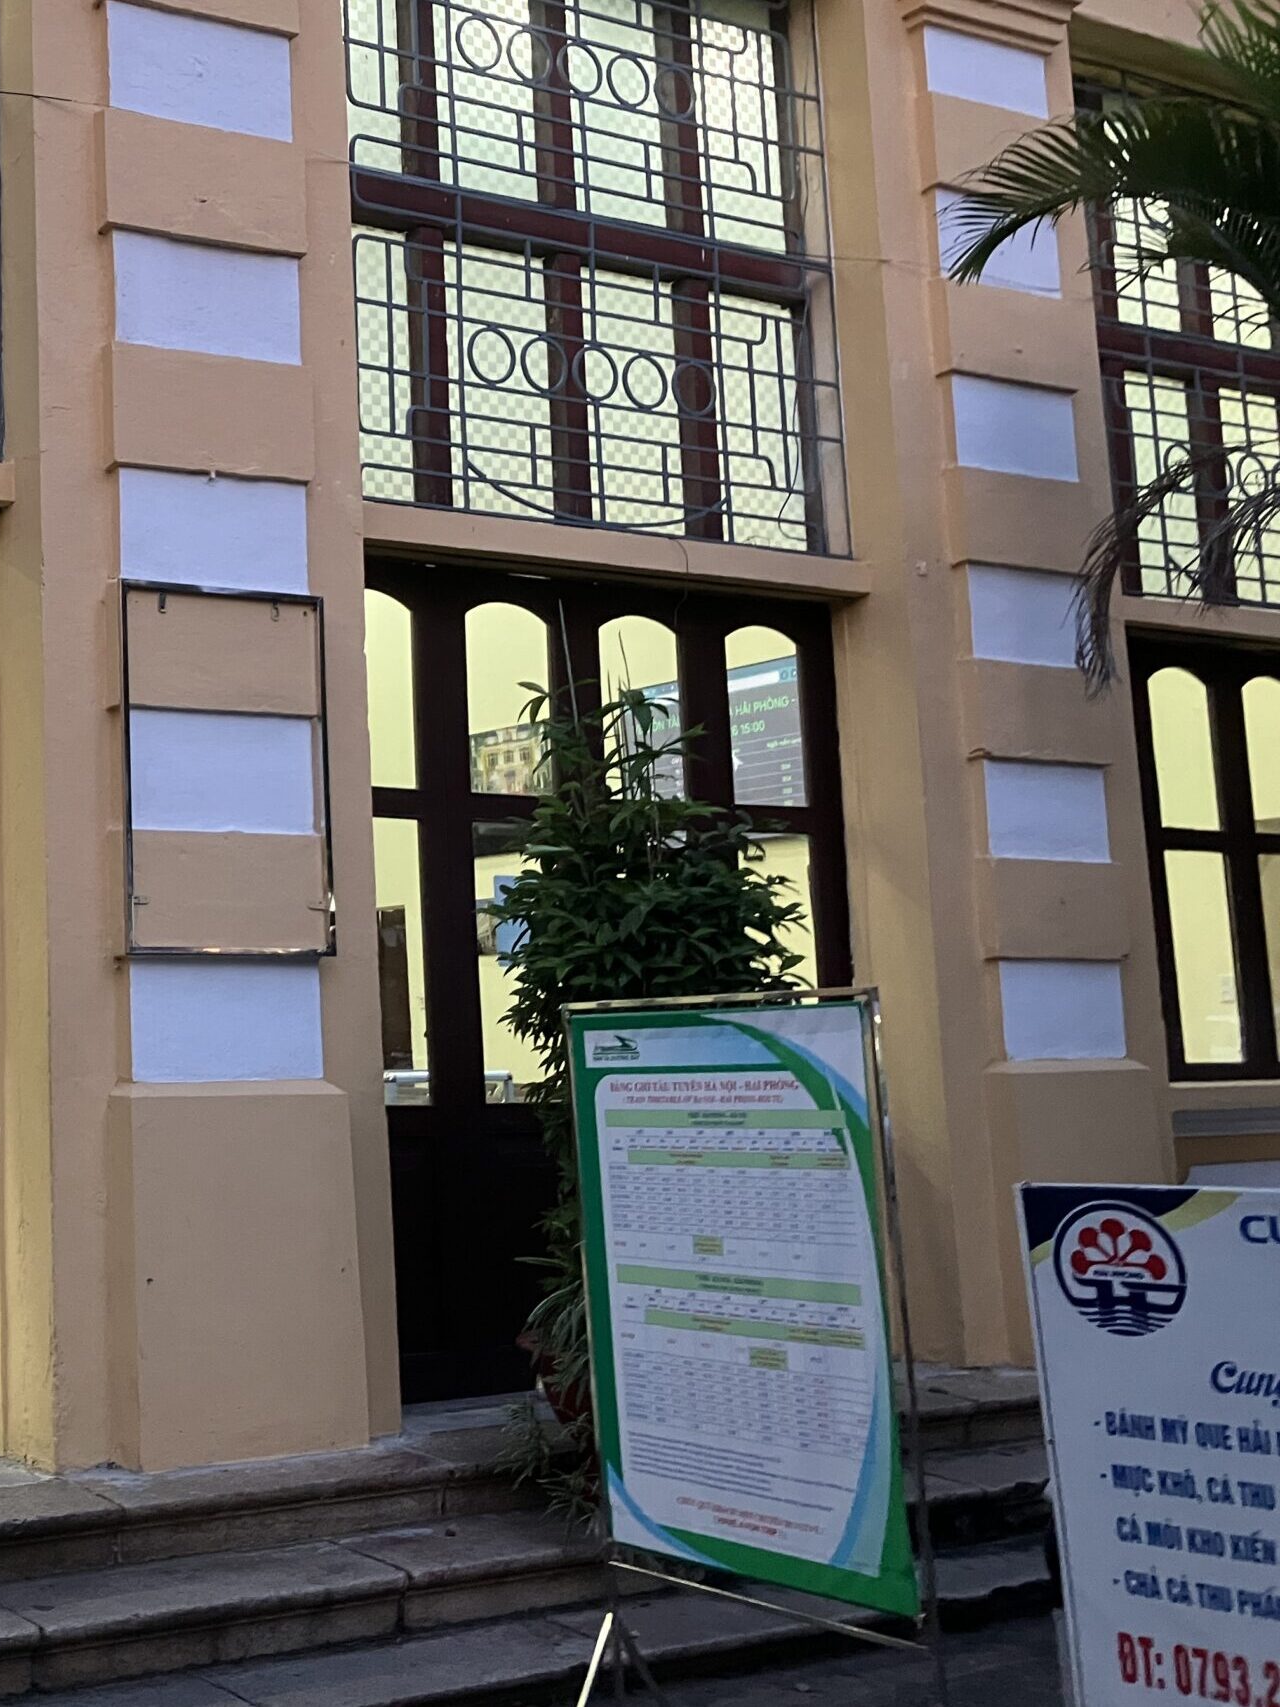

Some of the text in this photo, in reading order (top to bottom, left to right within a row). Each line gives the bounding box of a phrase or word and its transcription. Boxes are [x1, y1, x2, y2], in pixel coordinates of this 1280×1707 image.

[1195, 1422, 1232, 1450] QUE
[1206, 1473, 1235, 1504] CÁ
[1237, 1481, 1276, 1511] THU
[1116, 1513, 1142, 1544] CÁ
[1166, 1574, 1193, 1606] CÁ
[1196, 1583, 1232, 1613] THU
[1117, 1631, 1166, 1689] ĐT:
